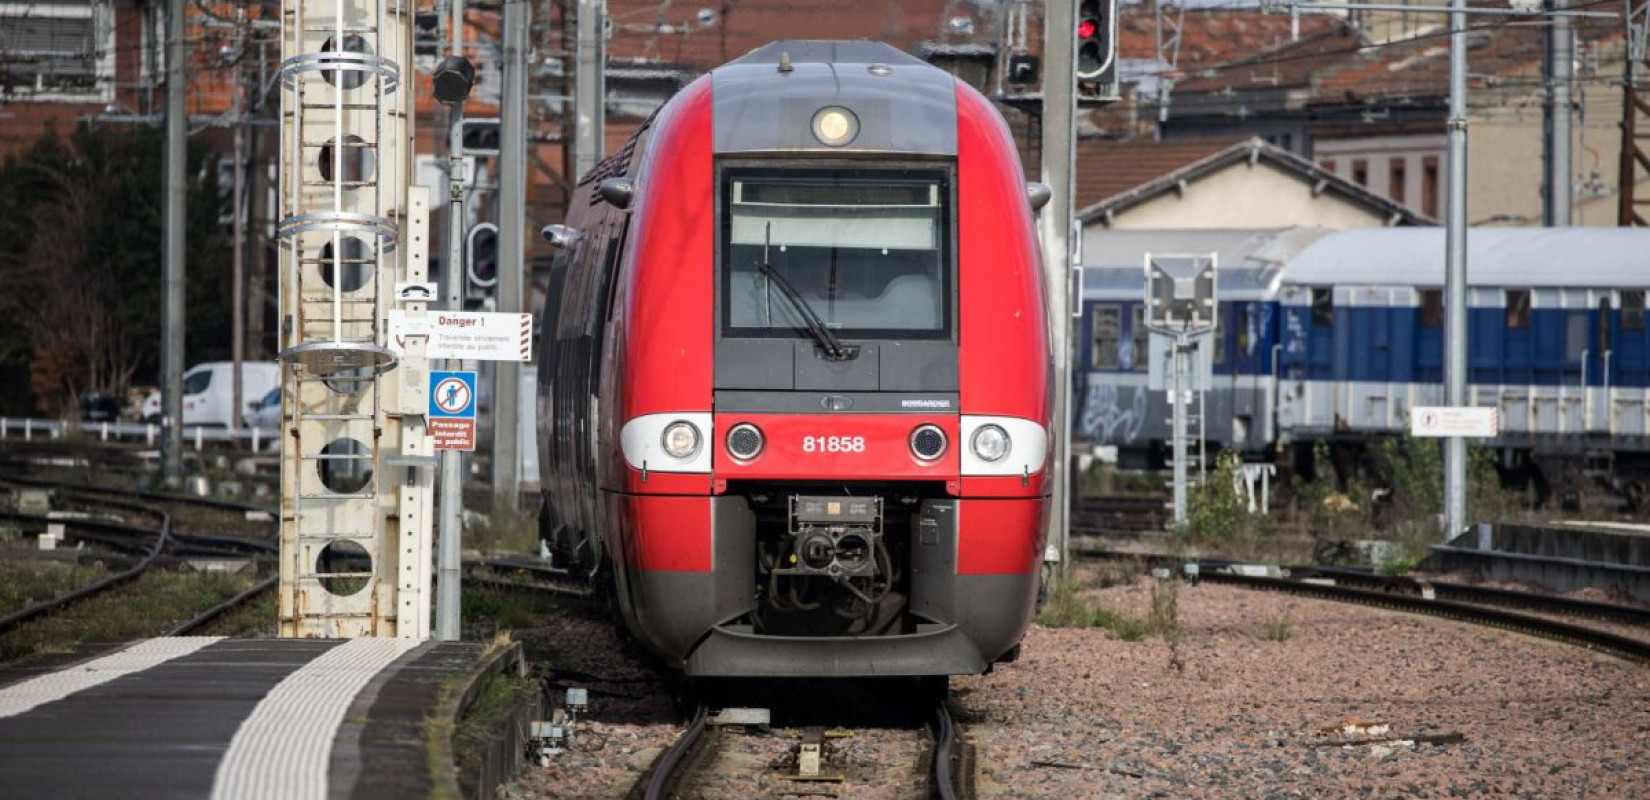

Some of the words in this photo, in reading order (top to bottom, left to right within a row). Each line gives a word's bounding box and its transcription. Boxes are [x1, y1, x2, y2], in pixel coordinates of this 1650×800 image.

[439, 315, 477, 327] Danger
[481, 316, 485, 327] !
[432, 421, 470, 429] Passage
[435, 430, 467, 438] interdit
[445, 438, 471, 446] public
[802, 435, 866, 453] 81858
